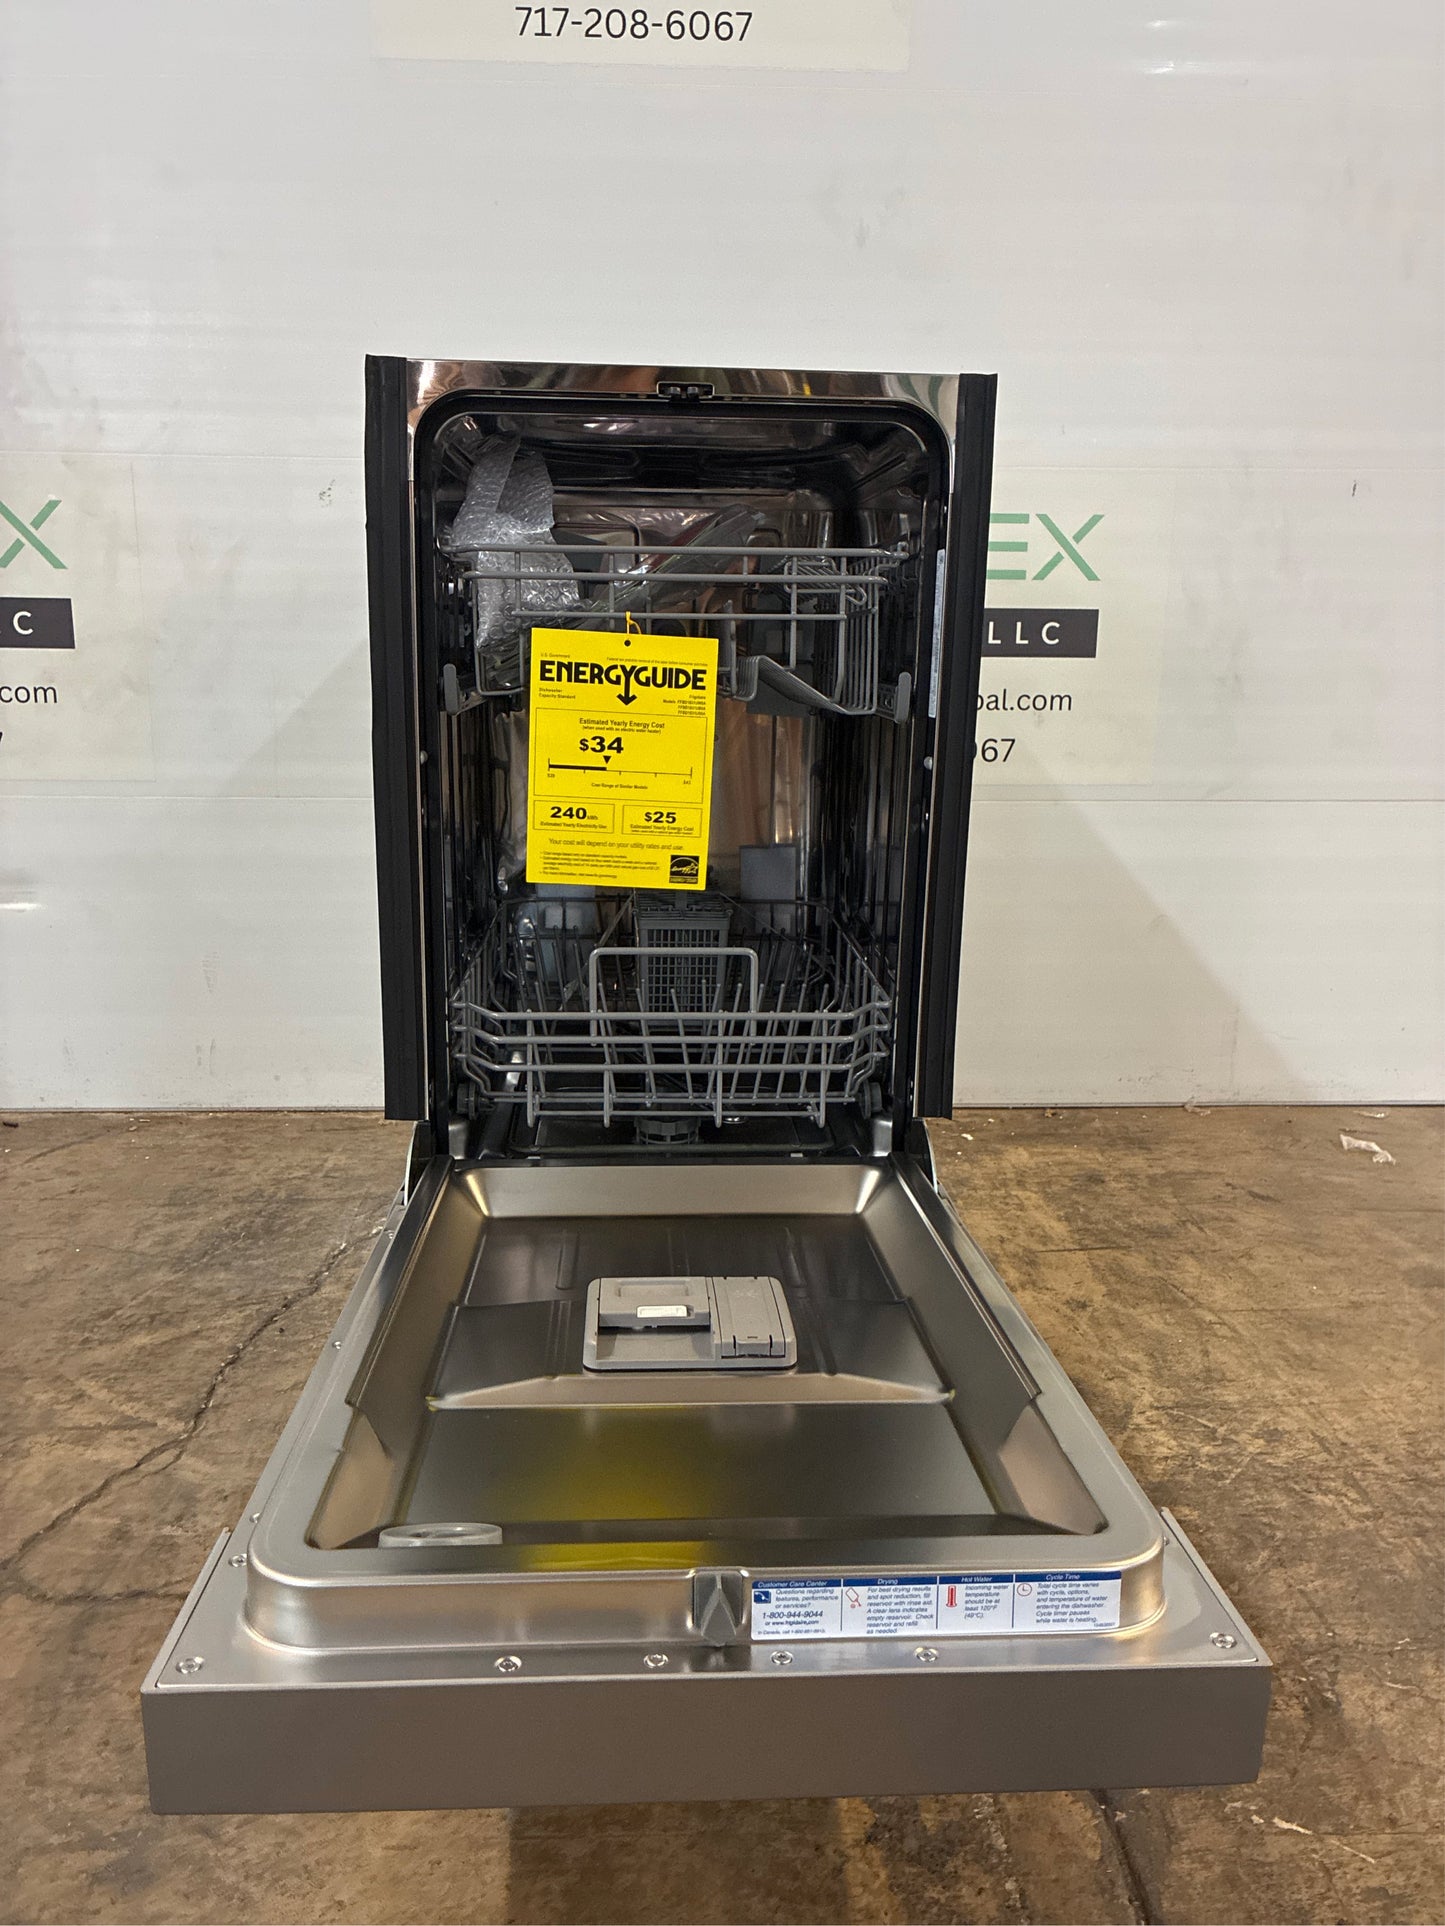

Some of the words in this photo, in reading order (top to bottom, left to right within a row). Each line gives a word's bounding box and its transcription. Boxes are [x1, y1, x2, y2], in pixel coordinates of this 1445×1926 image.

[516, 6, 754, 41] 717-208-6067
[988, 621, 1061, 645] LLC
[539, 659, 707, 691] ENERGYGUIDE
[579, 717, 609, 726] Estimated
[609, 719, 628, 728] Yearly
[629, 720, 650, 729] Energy
[651, 721, 666, 729] Cost
[579, 736, 625, 754] $34
[550, 806, 588, 820] 240
[643, 811, 677, 824] $25
[586, 840, 608, 848] depend
[877, 1578, 899, 1586] Drying
[762, 1610, 824, 1619] 1-800-944-9044
